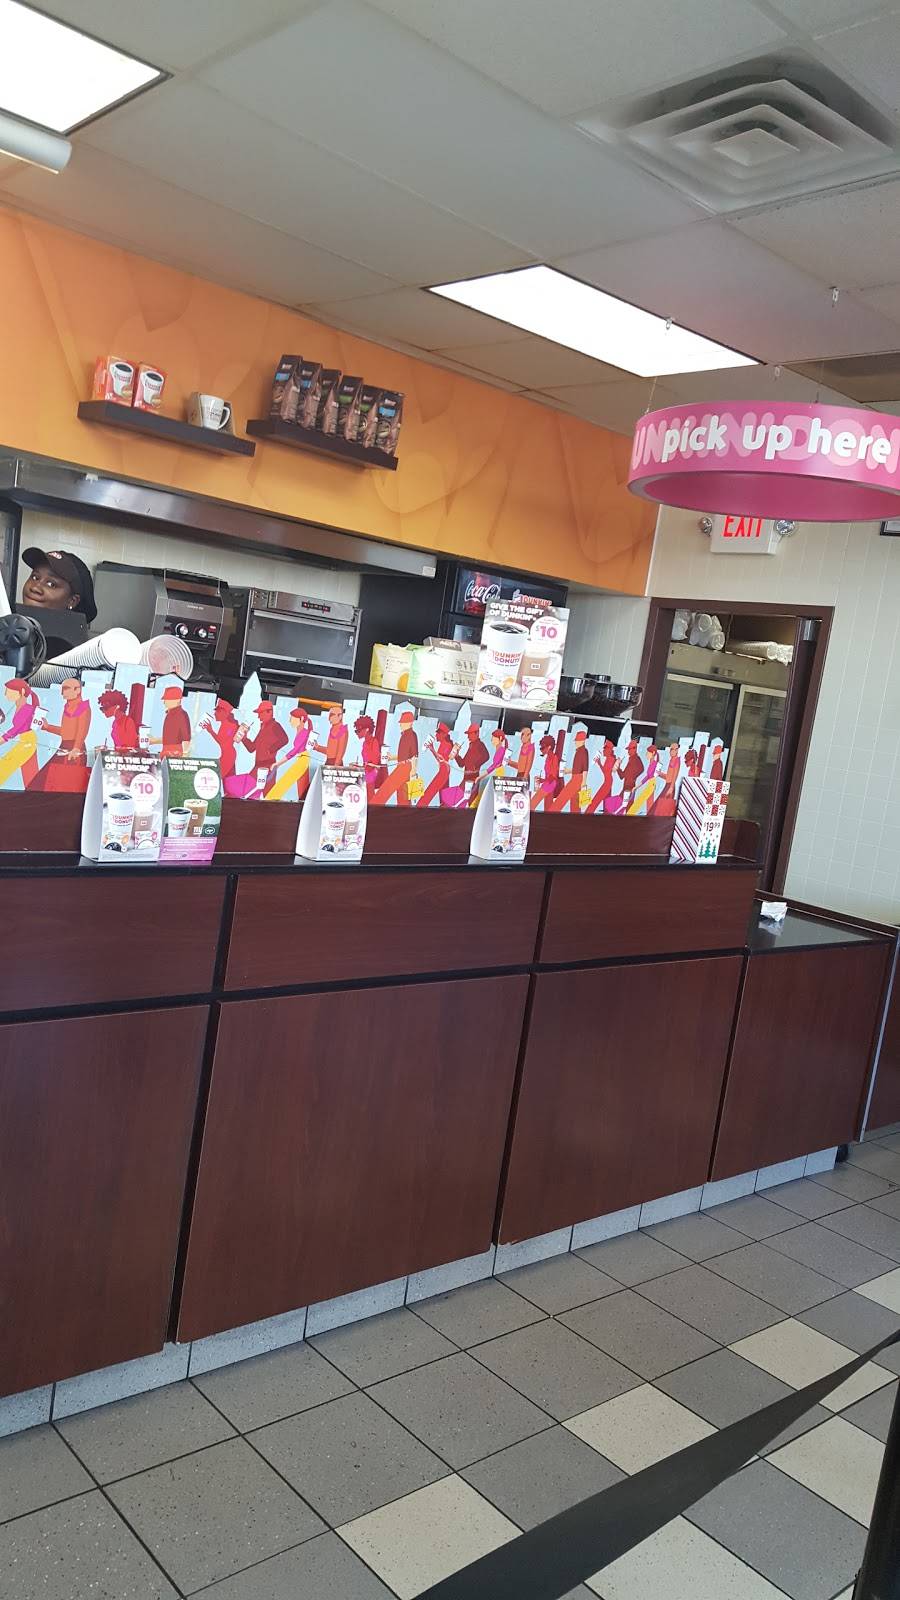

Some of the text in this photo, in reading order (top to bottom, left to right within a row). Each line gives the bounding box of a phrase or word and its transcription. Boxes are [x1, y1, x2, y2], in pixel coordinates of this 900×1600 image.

[660, 414, 893, 465] pick up here
[723, 515, 764, 538] EXIT
[490, 602, 545, 616] GIVE THE GIFT
[535, 624, 558, 639] $10
[140, 757, 159, 766] GIFT
[134, 781, 154, 795] $10
